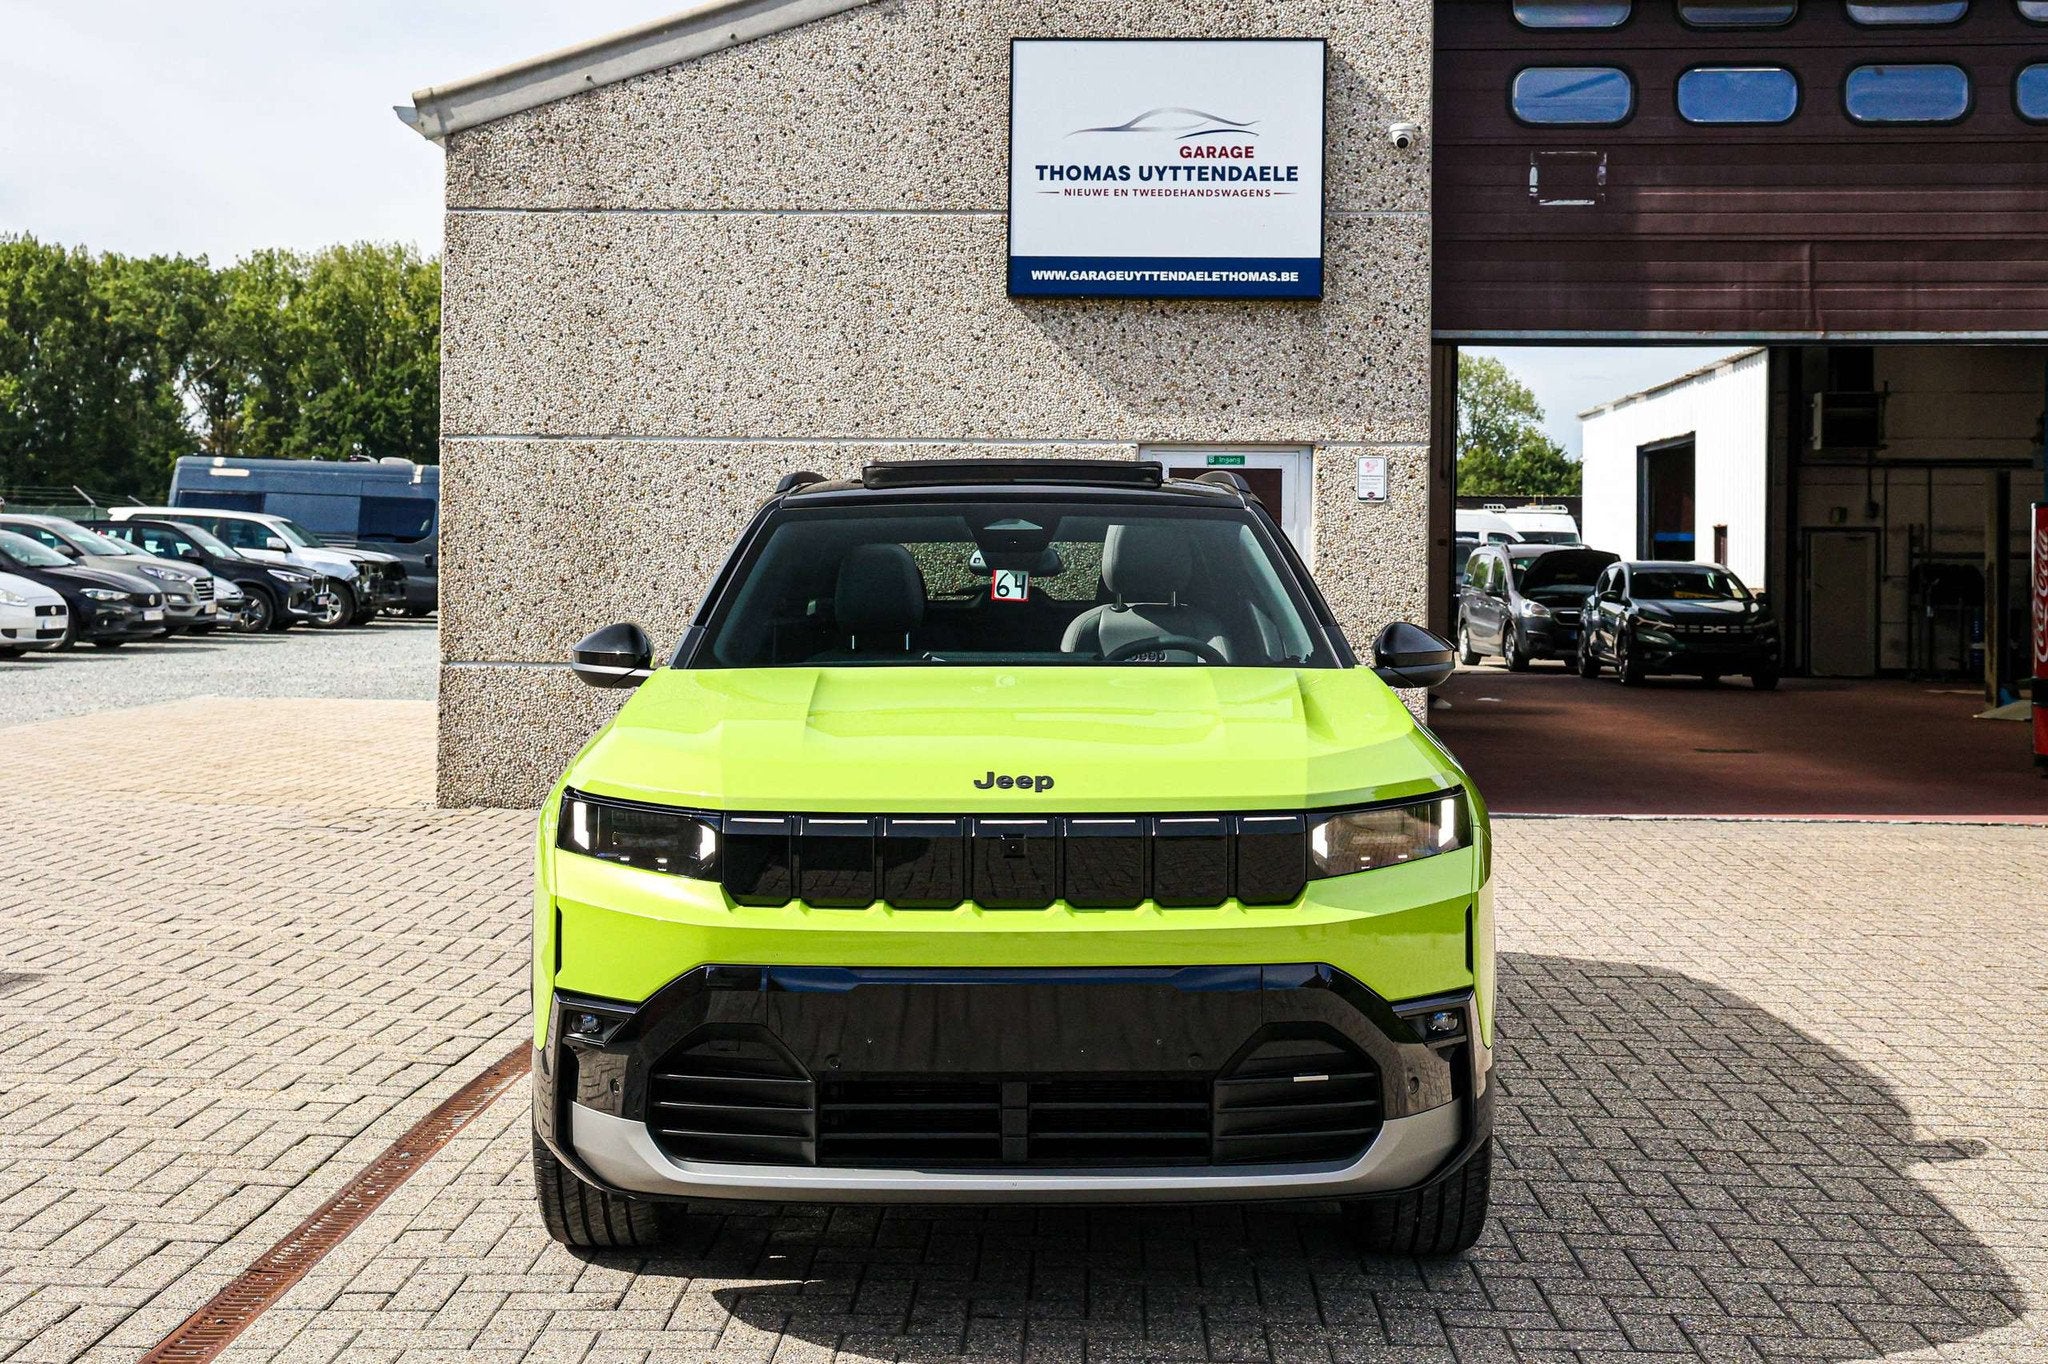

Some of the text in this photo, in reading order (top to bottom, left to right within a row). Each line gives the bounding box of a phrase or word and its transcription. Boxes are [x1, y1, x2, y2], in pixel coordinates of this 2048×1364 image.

[1179, 145, 1255, 159] GARAGE
[1035, 164, 1299, 182] THOMAS UYTTENDAELE
[1064, 188, 1271, 198] NIEUWE EN TWEEDEHANDSWAGENS
[1031, 270, 1299, 282] WWW.GARAGEUYTTENDAELETHOMAS.BE
[1218, 457, 1241, 465] Ingang
[996, 573, 1026, 598] 64
[973, 771, 1055, 793] Jeep
